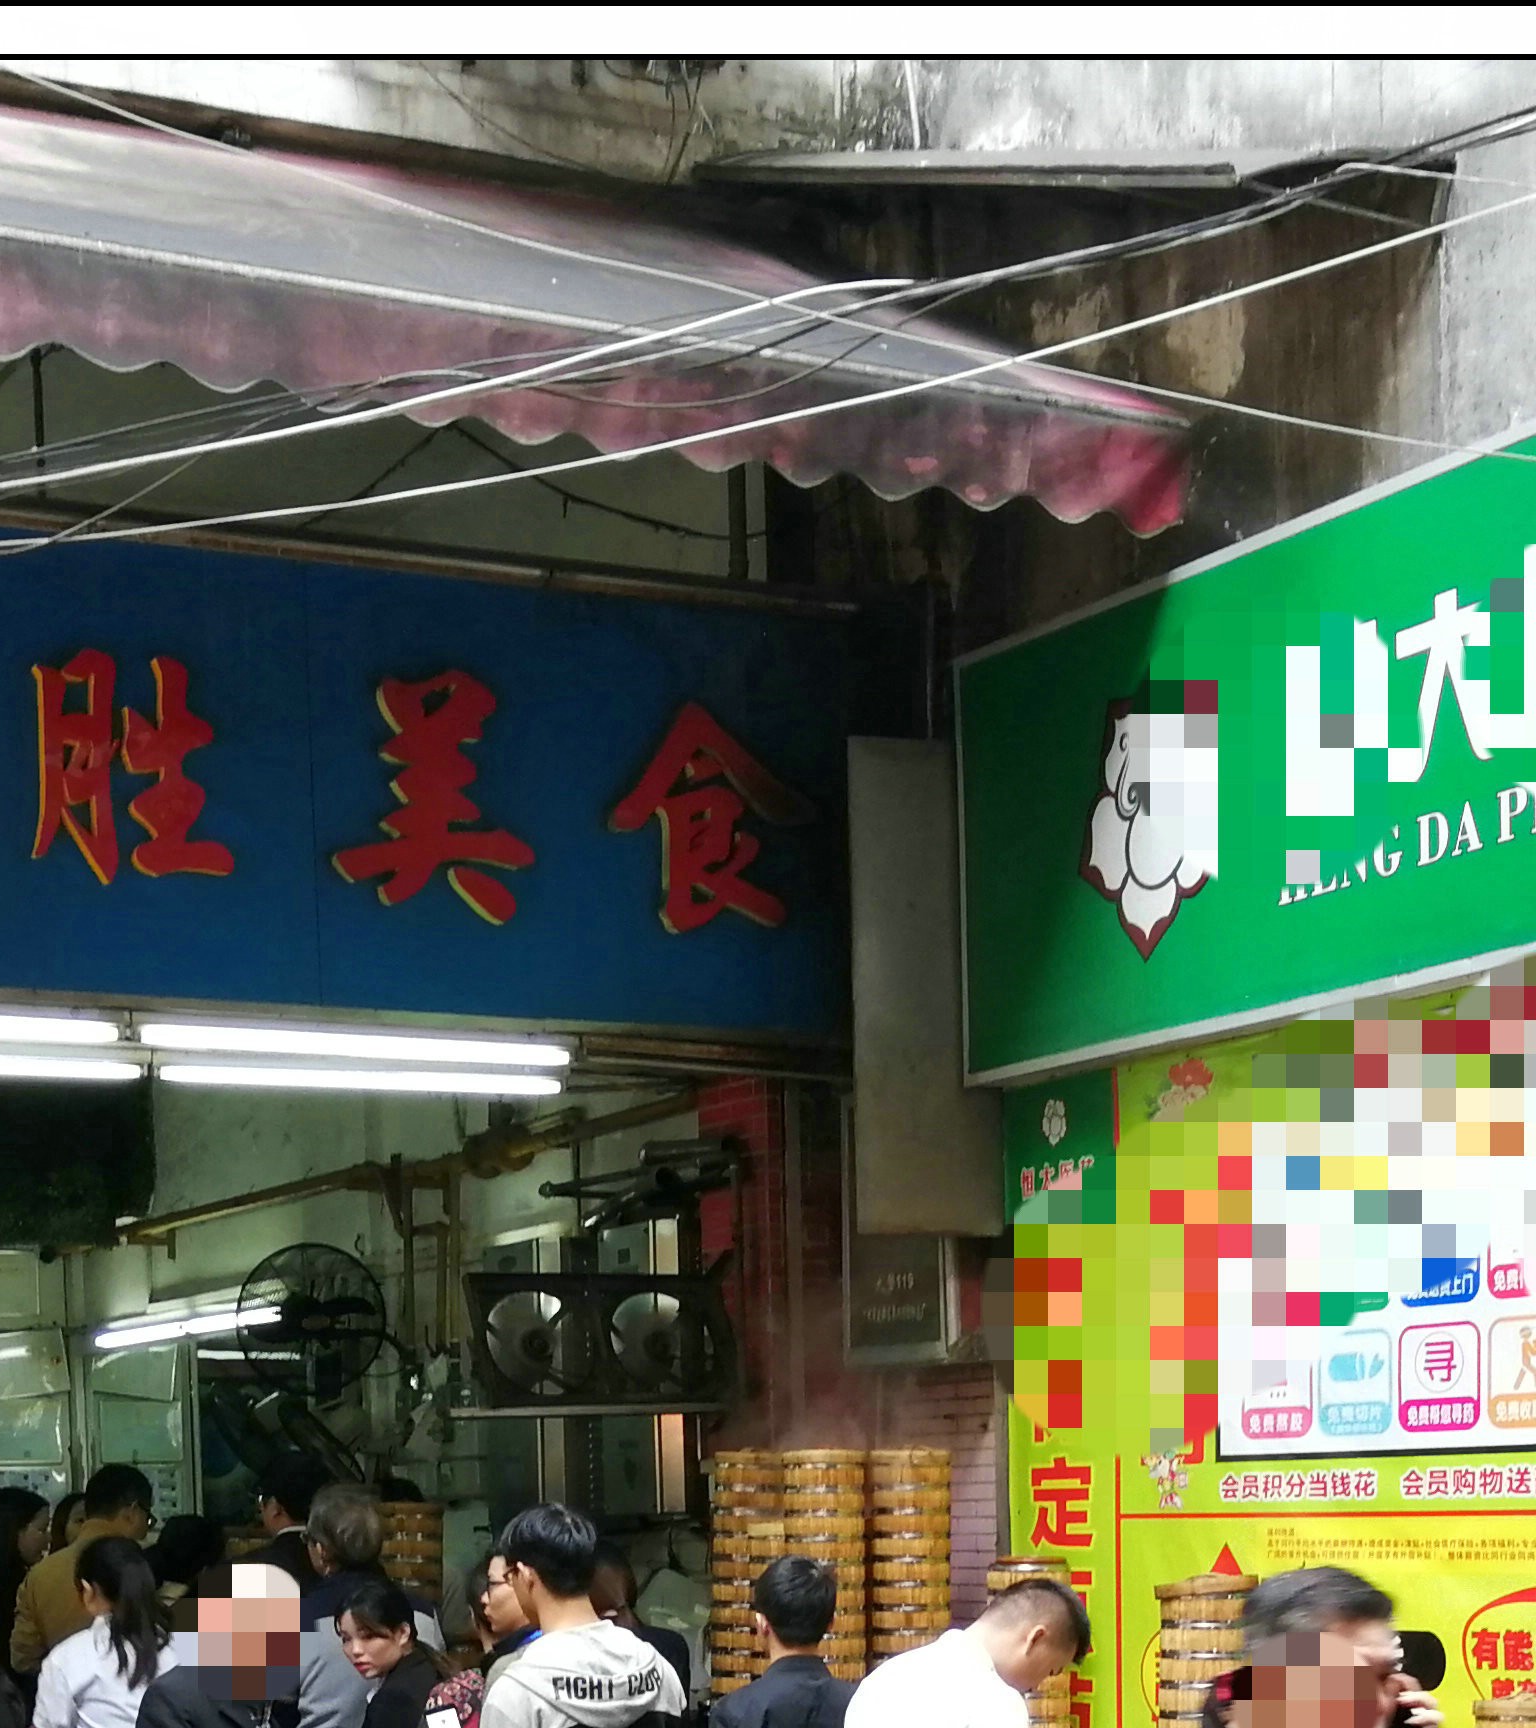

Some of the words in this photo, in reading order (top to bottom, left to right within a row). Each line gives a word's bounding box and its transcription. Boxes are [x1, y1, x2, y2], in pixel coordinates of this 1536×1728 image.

[1416, 799, 1484, 868] DA
[1424, 1340, 1457, 1383] 寻
[1220, 1469, 1376, 1501] 会员积分当钱花
[552, 1674, 614, 1701] FIGHT
